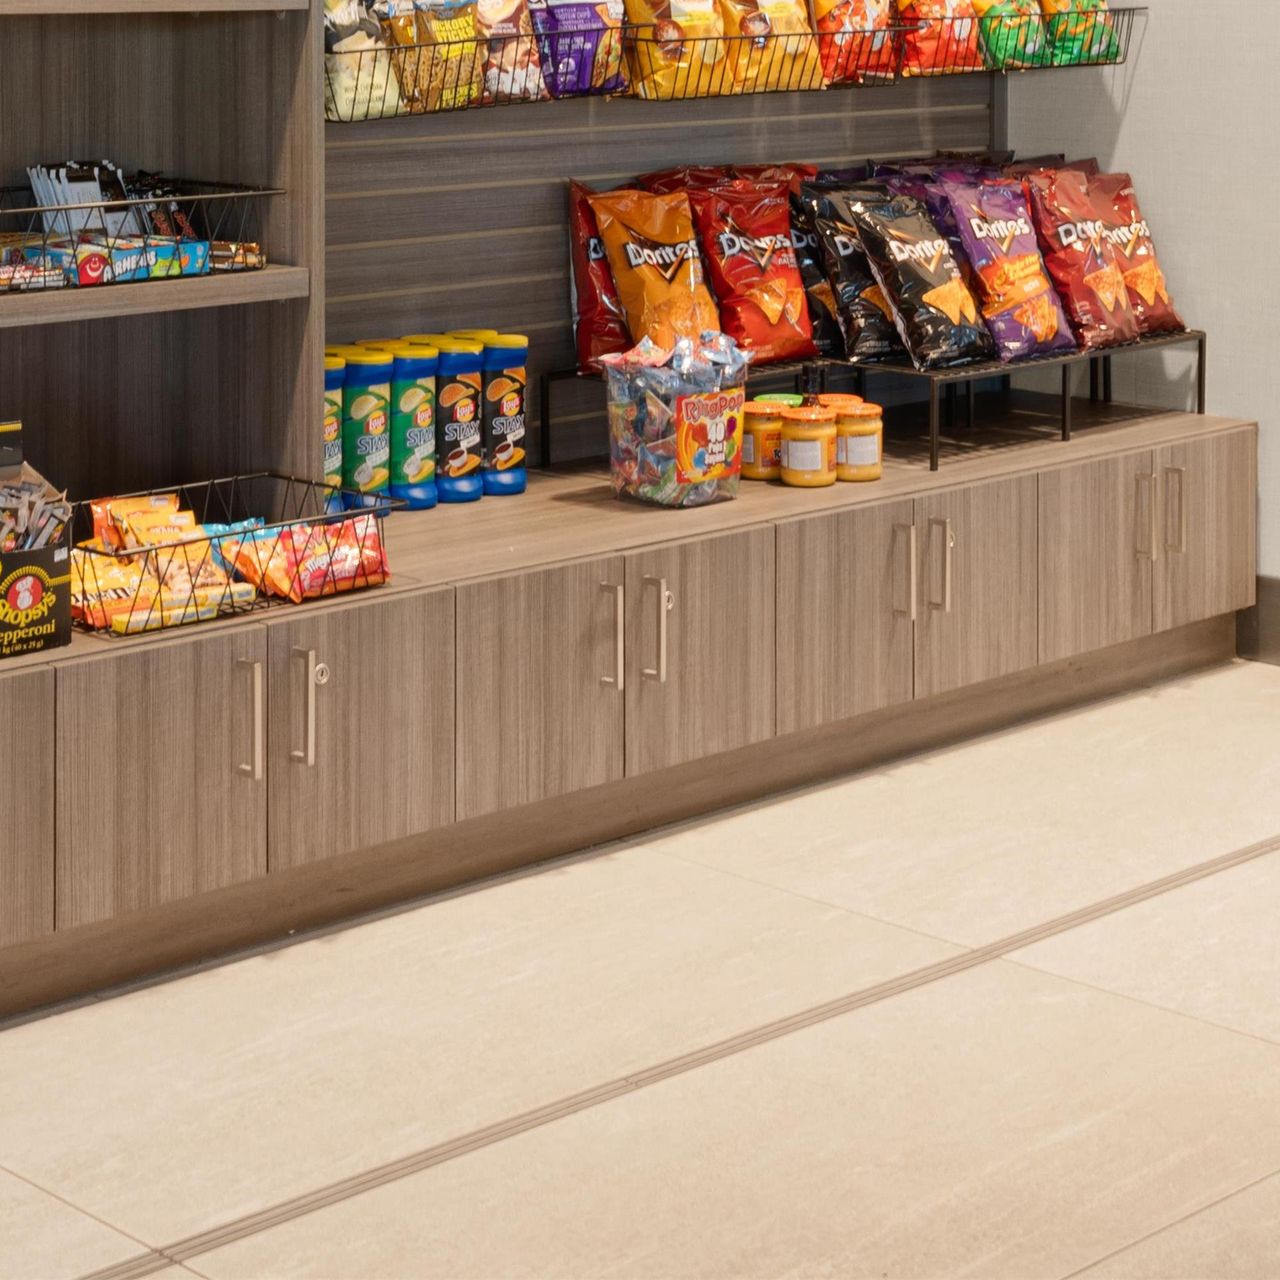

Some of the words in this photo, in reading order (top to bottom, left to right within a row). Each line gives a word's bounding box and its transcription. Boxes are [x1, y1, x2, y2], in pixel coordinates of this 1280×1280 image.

[970, 217, 1031, 240] Doritos
[104, 251, 157, 283] ARHEADS
[626, 237, 699, 268] Doritos
